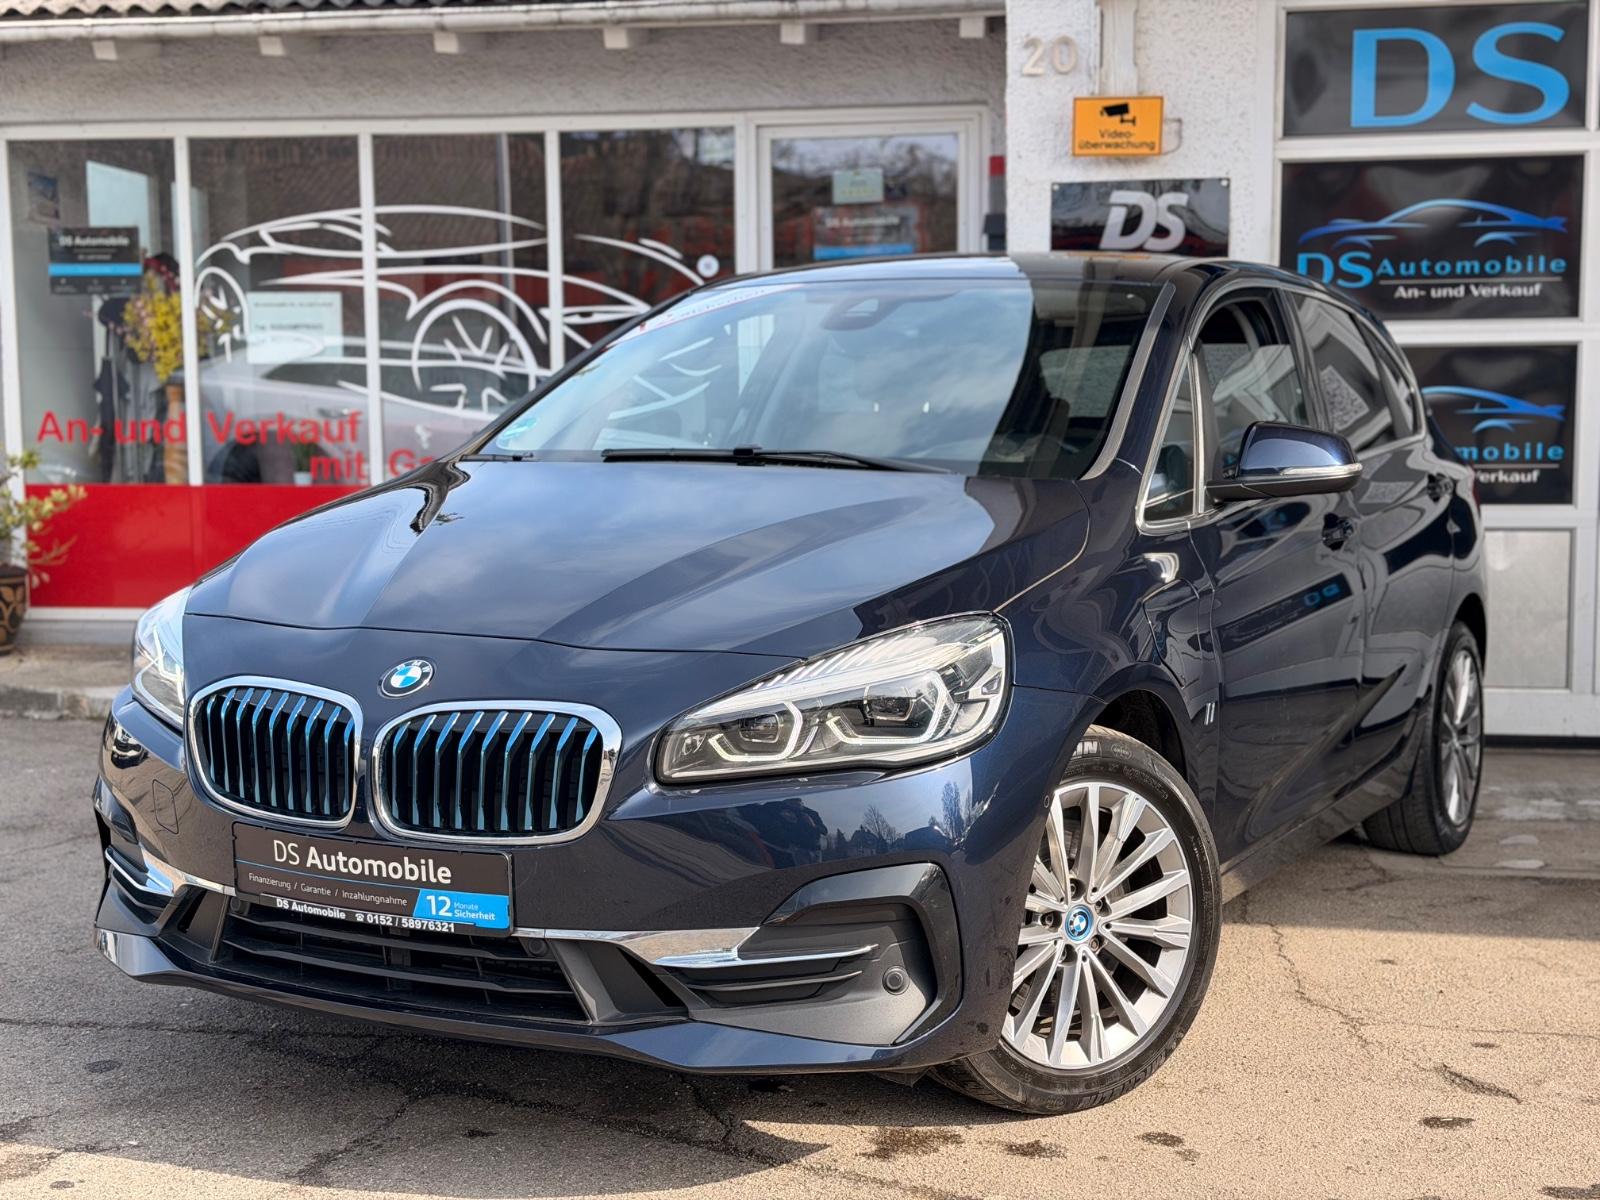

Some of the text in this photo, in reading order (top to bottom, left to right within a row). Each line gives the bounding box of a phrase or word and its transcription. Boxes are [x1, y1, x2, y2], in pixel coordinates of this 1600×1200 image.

[1022, 35, 1077, 77] 20
[1350, 20, 1570, 128] DS
[1079, 138, 1156, 151] überwachung
[1099, 129, 1135, 139] Video-
[1100, 190, 1189, 251] DS
[1297, 251, 1567, 288] DS Automobile
[1394, 282, 1543, 298] An- und Verkauf
[37, 411, 362, 444] An- und Verkauf
[310, 451, 366, 479] mit
[273, 840, 453, 884] DS Automobile
[248, 872, 292, 891] Finanzierung
[300, 883, 332, 897] Garantie
[342, 890, 408, 907] Inzahlungnahme
[426, 895, 453, 917] 12
[276, 898, 290, 909] DS
[291, 902, 346, 920] Automobile
[366, 914, 393, 926] 0152
[401, 918, 456, 933] 58976321
[454, 909, 496, 921] Sicherheit
